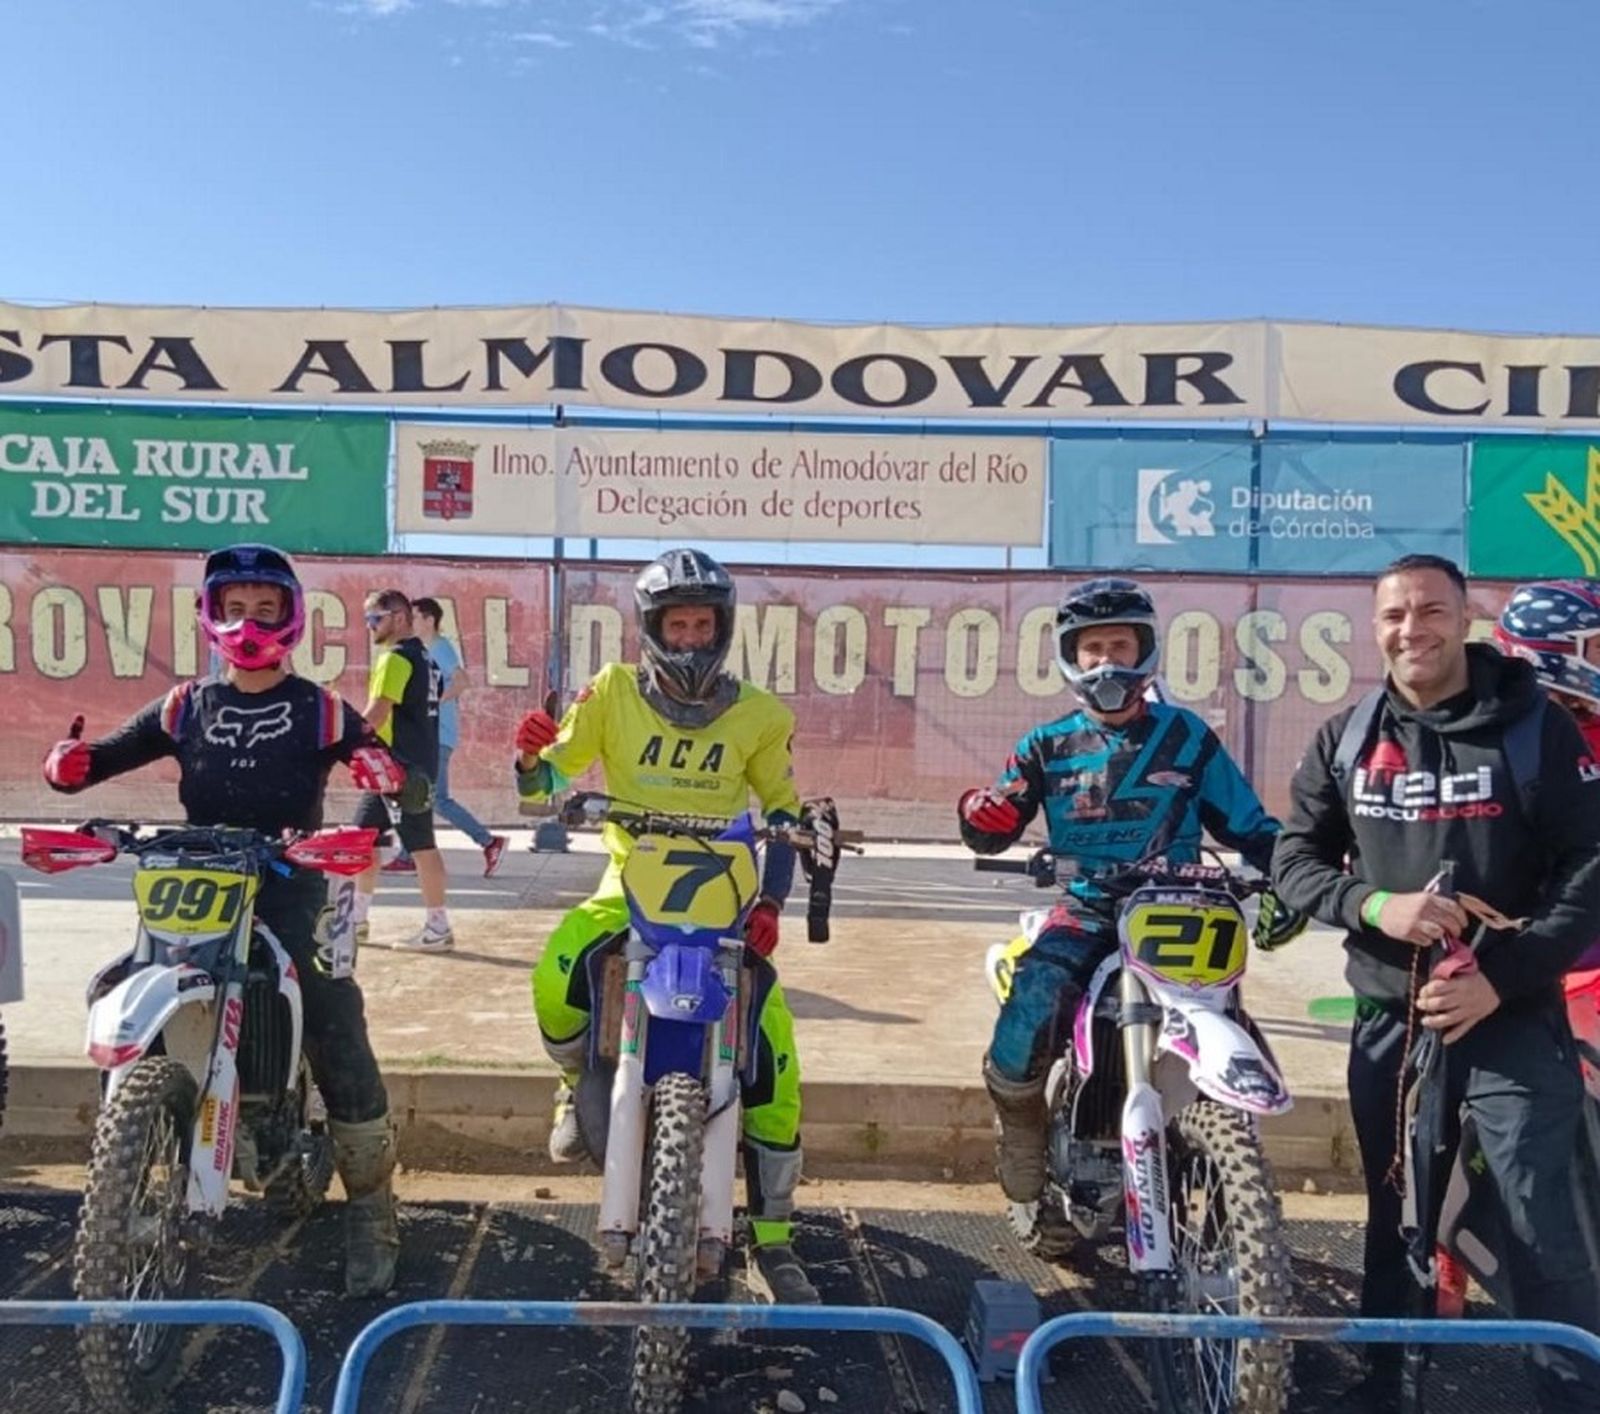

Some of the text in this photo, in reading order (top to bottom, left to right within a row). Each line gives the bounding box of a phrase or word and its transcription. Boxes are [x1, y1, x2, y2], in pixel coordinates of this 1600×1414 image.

[271, 336, 1247, 408] ALMODOVAR
[0, 434, 309, 481] CAJA RURAL
[492, 444, 1028, 487] Ilmo. Ayuntamiento de Almodóvar del Río
[31, 481, 270, 525] DEL SUR
[596, 486, 922, 527] Delegación de deportes
[1231, 486, 1373, 514] Diputación
[1229, 514, 1375, 540] de Córdoba
[726, 604, 1352, 703] MOTOCOSS
[144, 877, 243, 922] 991
[660, 850, 735, 912] 7
[1137, 914, 1239, 970] 21
